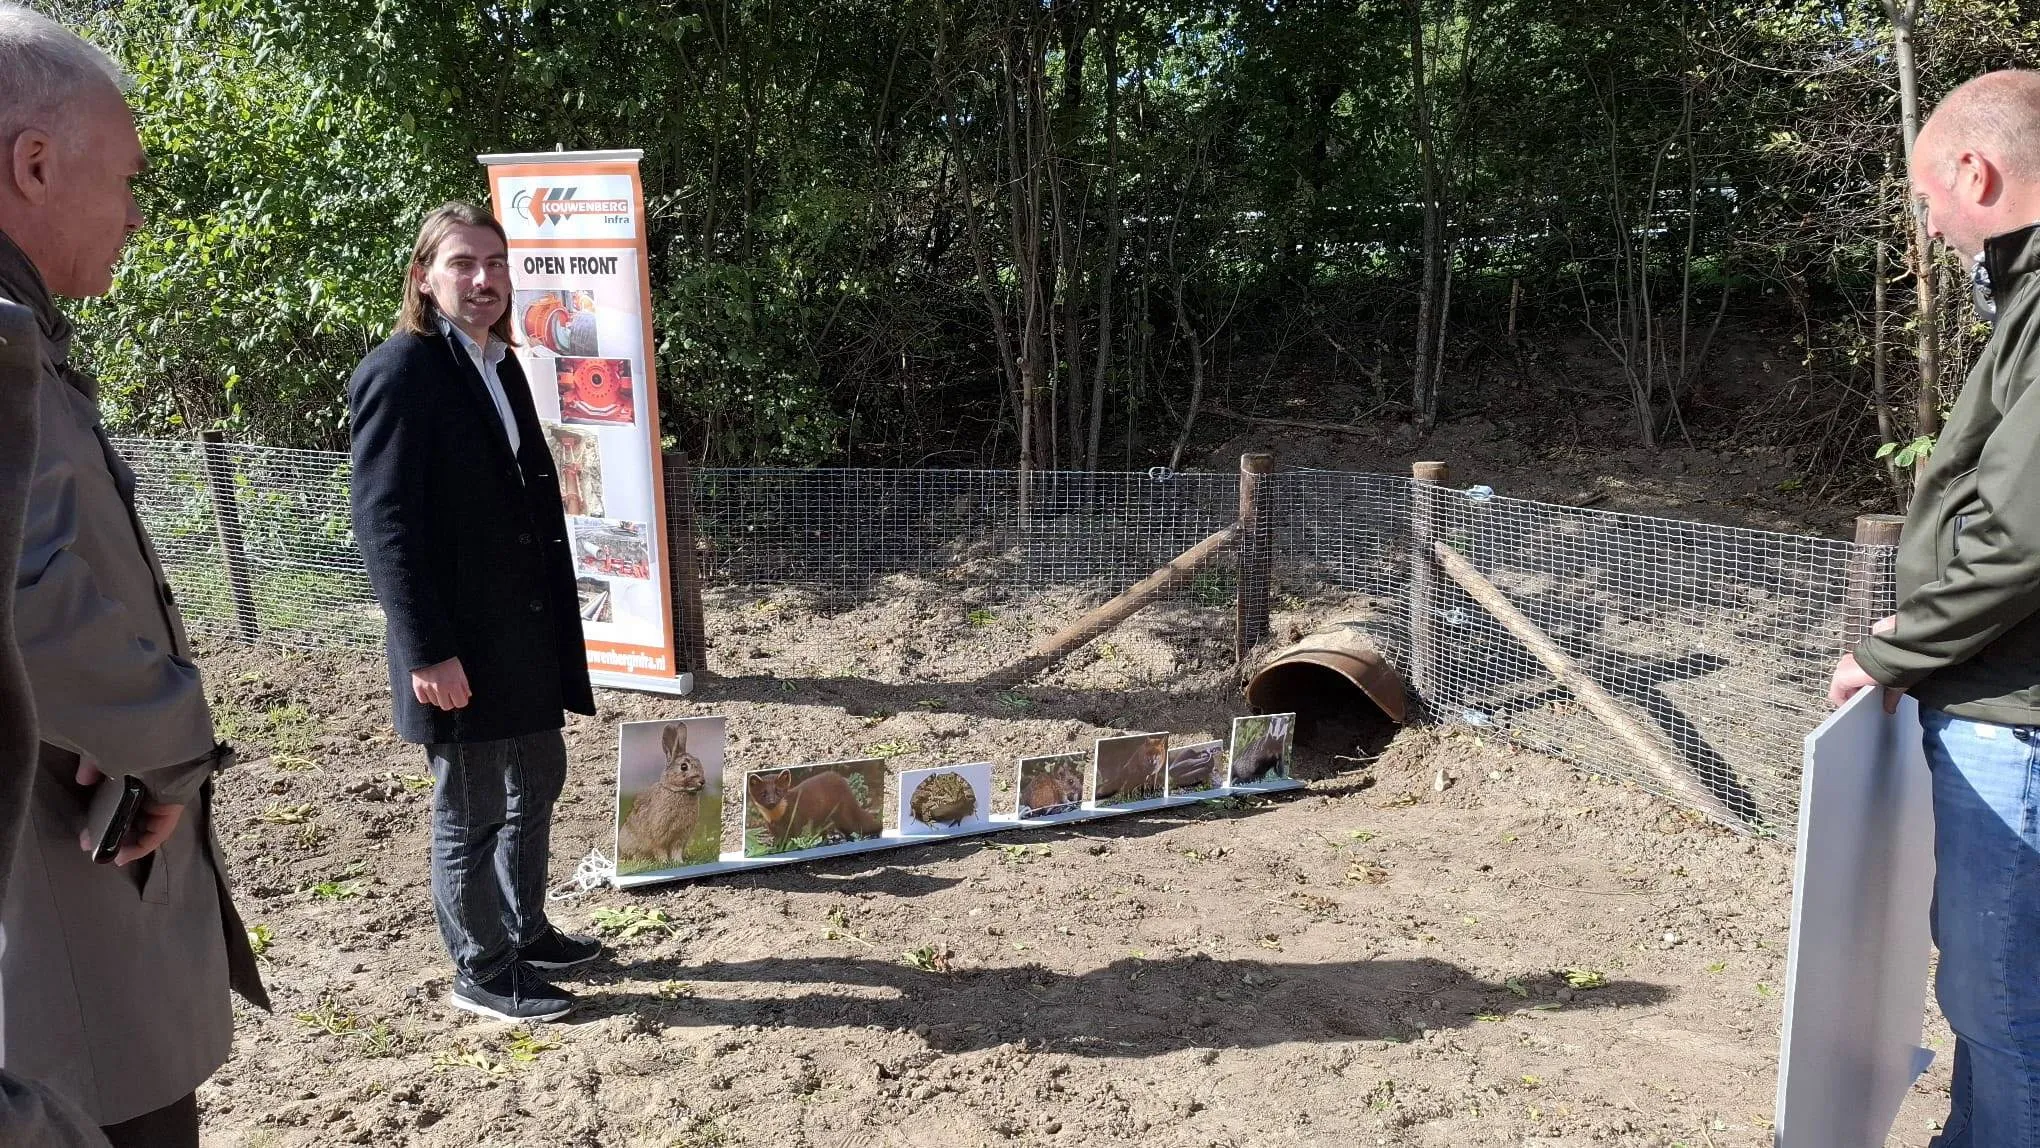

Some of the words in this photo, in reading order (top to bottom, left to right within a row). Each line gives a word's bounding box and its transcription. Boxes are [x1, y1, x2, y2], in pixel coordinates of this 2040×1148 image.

[542, 200, 627, 213] KOUWENBERG
[604, 215, 630, 224] Infra
[523, 256, 566, 275] OPEN
[569, 256, 618, 275] FRONT
